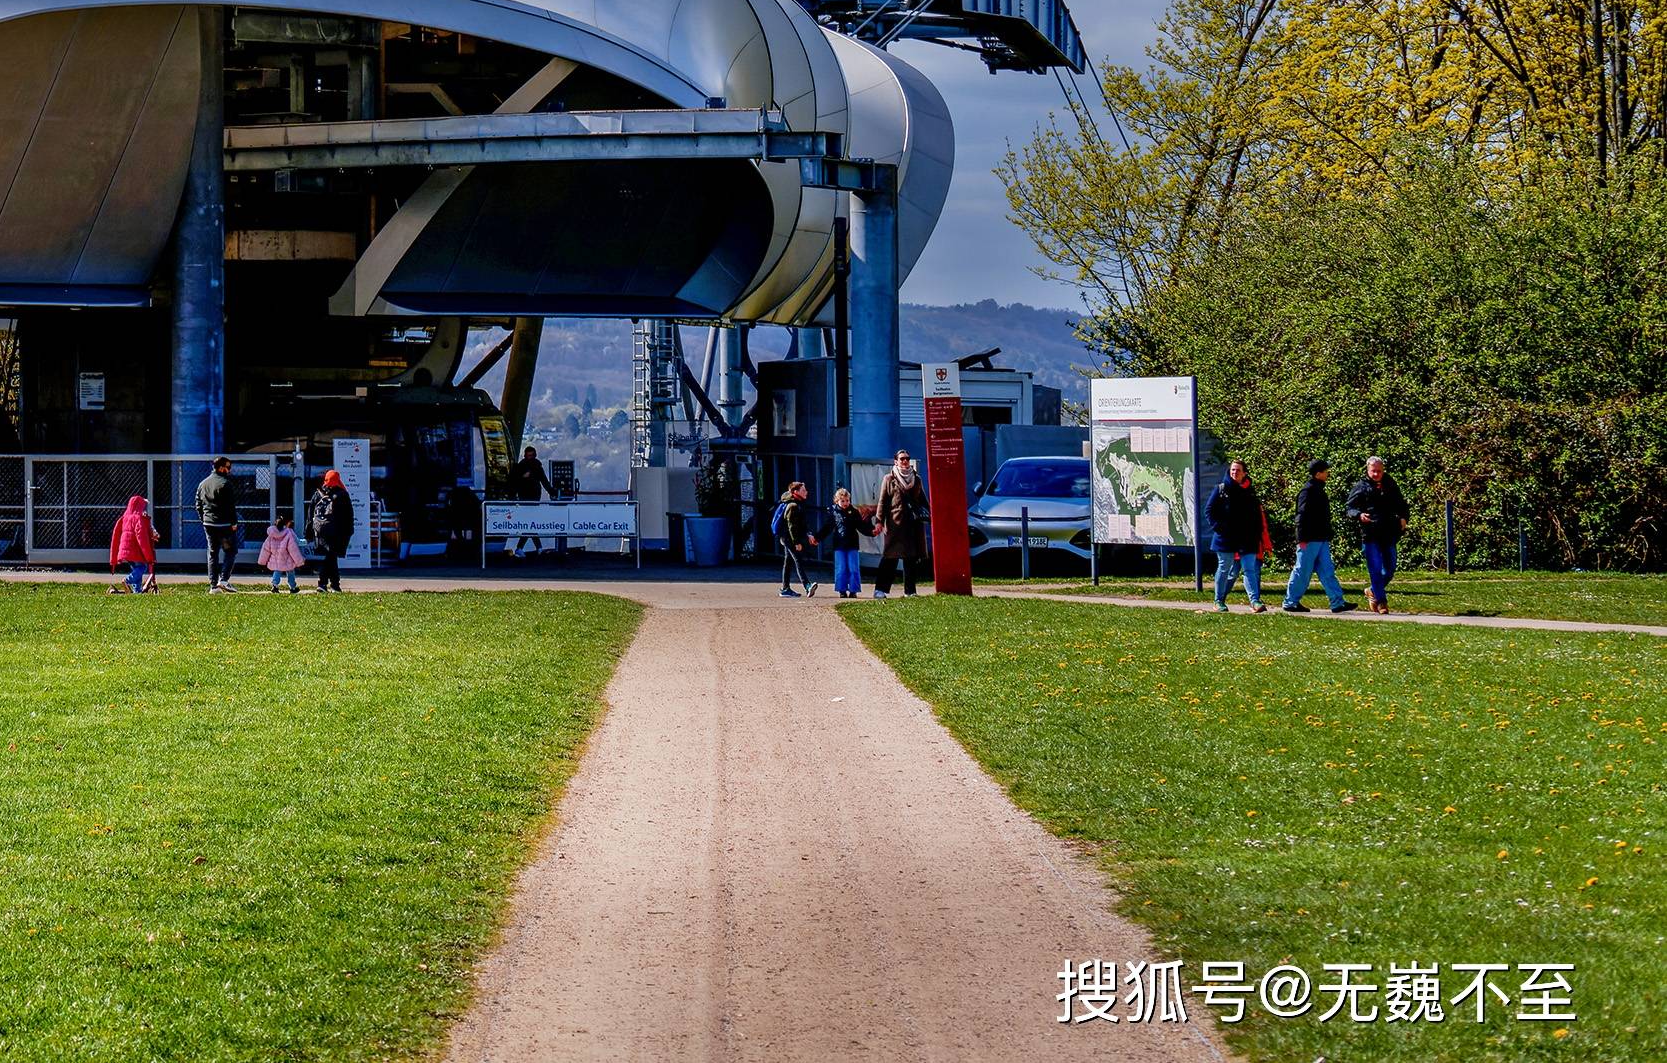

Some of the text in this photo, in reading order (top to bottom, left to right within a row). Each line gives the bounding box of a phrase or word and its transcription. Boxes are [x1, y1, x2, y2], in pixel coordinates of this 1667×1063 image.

[492, 521, 629, 531] Seilbahn Ausstieg Cable Car Exit
